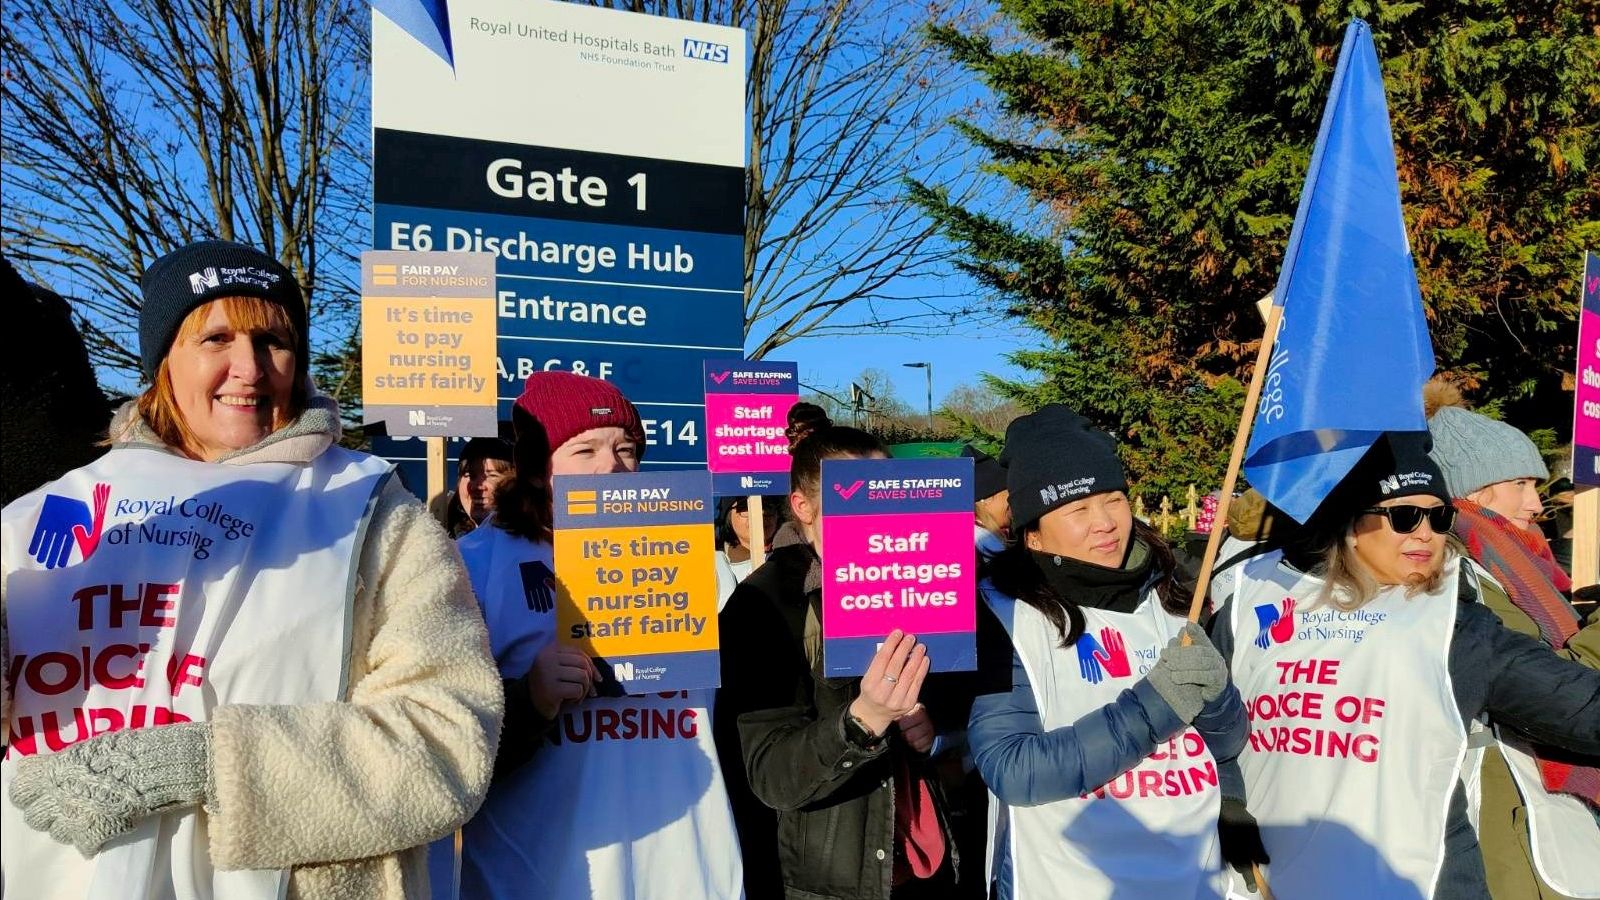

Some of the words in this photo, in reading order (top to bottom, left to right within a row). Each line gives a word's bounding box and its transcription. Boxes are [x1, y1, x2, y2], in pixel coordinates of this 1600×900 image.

[470, 17, 511, 37] Royal
[518, 24, 568, 43] United
[573, 31, 639, 53] Hospitals
[644, 42, 676, 58] Bath
[685, 39, 728, 63] NHS
[580, 51, 599, 62] NHS
[601, 54, 652, 70] Foundation
[654, 62, 676, 72] Trust
[486, 158, 608, 208] Gate
[627, 172, 647, 211] 1
[390, 221, 433, 252] E6
[446, 226, 617, 273] Discharge
[628, 242, 694, 274] Hub
[221, 267, 246, 277] Royal
[247, 267, 280, 283] College
[402, 265, 431, 275] FAIR
[433, 265, 459, 275] PAY
[223, 276, 232, 284] of
[235, 276, 269, 289] Nursing
[402, 277, 427, 286] FOR
[431, 277, 488, 287] NURSING
[386, 307, 418, 323] It's
[423, 306, 473, 323] time
[498, 290, 647, 326] Entrance
[397, 330, 419, 345] to
[424, 333, 463, 349] pay
[389, 351, 472, 371] nursing
[375, 373, 426, 389] staff
[430, 372, 486, 393] fairly
[732, 371, 754, 379] SAFE
[734, 406, 773, 419] Staff
[715, 424, 787, 439] shortage
[719, 444, 752, 455] cost
[868, 479, 900, 489] SAFE
[902, 478, 962, 489] STAFFING
[1057, 481, 1074, 491] Royal
[602, 489, 638, 501] FAIR
[640, 488, 671, 500] PAY
[868, 490, 907, 500] SAVES
[909, 489, 943, 499] LIVES
[603, 502, 633, 514] FOR
[637, 499, 704, 514] NURSING
[114, 496, 175, 521] Royal
[179, 498, 255, 541] College
[107, 522, 134, 545] of
[138, 524, 215, 560] Nursing
[583, 538, 623, 559] It's
[629, 536, 691, 557] time
[868, 531, 930, 553] Staff
[596, 567, 624, 585] to
[632, 566, 679, 587] pay
[835, 561, 962, 583] shortages
[71, 583, 181, 631] THE
[587, 588, 689, 611] nursing
[840, 590, 894, 611] cost
[901, 587, 957, 608] lives
[571, 616, 633, 639] staff
[639, 613, 707, 636] fairly
[1301, 610, 1335, 627] Royal
[1337, 609, 1387, 625] College
[1298, 627, 1312, 641] of
[1316, 626, 1366, 643] Nursing
[635, 666, 648, 674] Royal
[1276, 659, 1340, 685] THE
[1247, 691, 1324, 722] VOICE
[1334, 696, 1386, 725] OF
